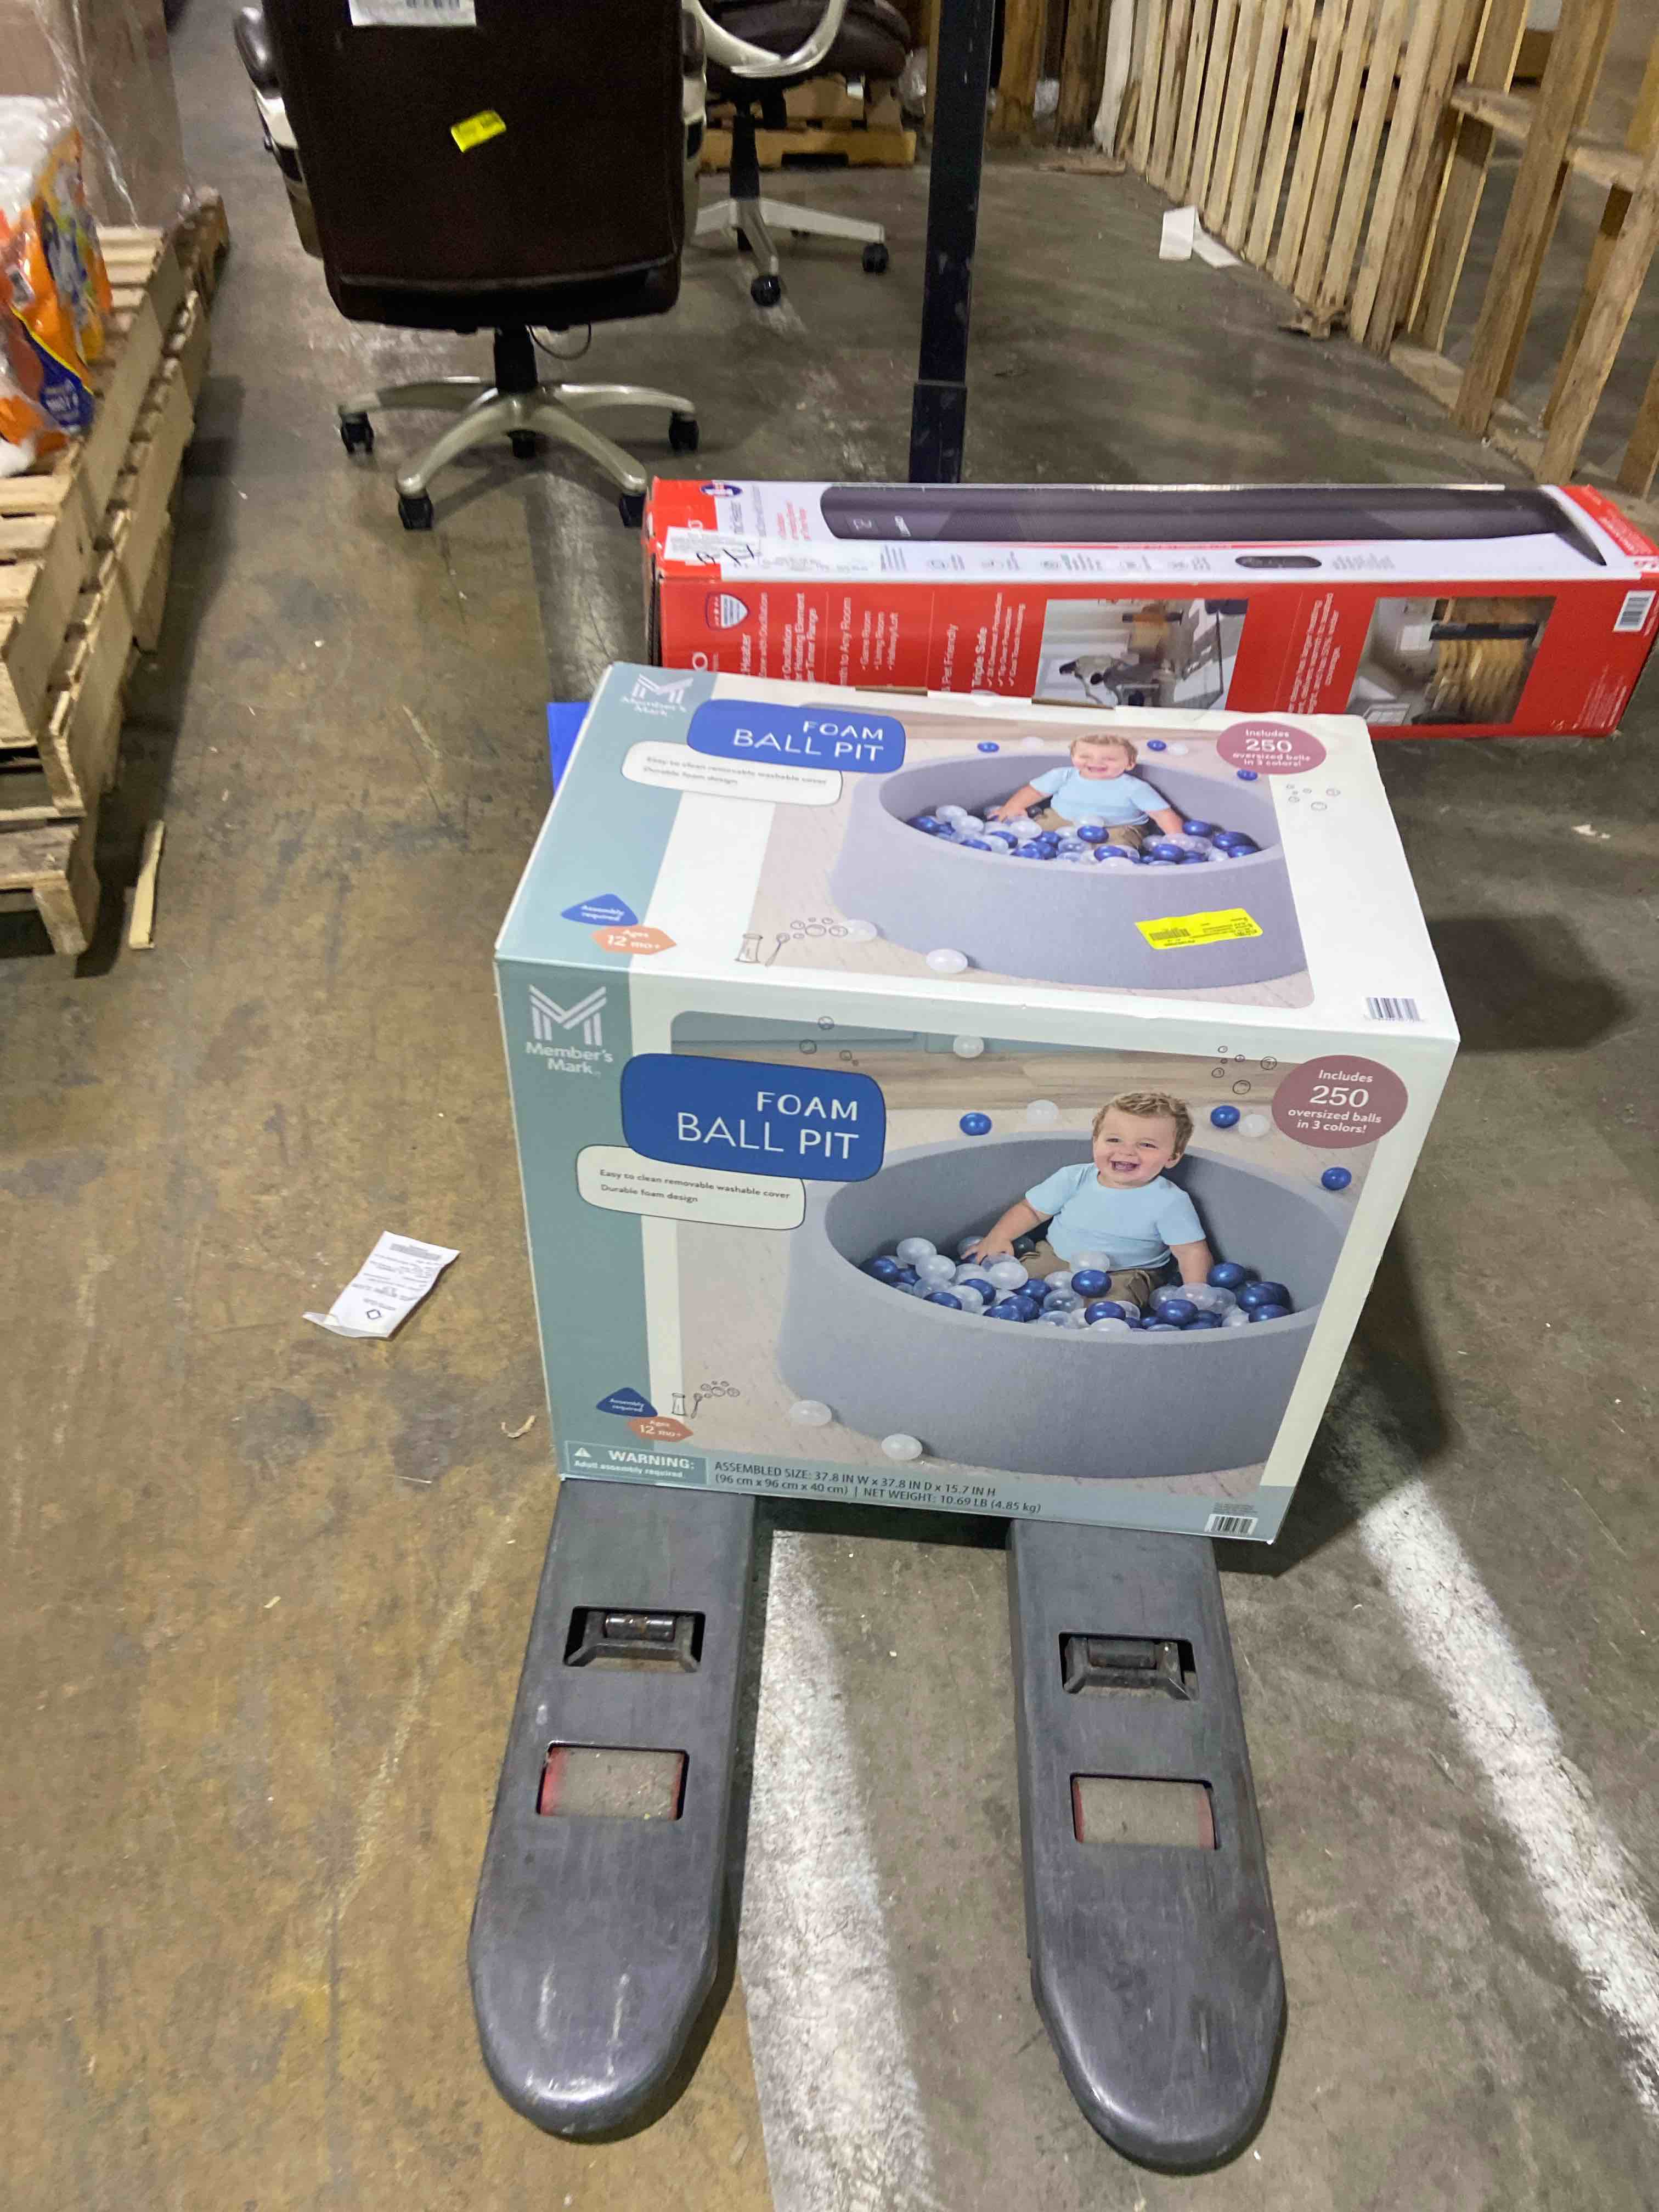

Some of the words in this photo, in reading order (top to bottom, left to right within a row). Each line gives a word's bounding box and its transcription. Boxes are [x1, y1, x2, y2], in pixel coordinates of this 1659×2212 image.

[803, 720, 883, 741] FOAM
[1246, 729, 1290, 738] Includes
[733, 728, 822, 755] BALL
[834, 741, 884, 761] PIT
[1246, 738, 1293, 753] 250
[607, 934, 628, 947] 12
[525, 1042, 613, 1063] Member's
[548, 1057, 593, 1074] Mark
[1318, 1070, 1373, 1083] Includes
[1309, 1085, 1369, 1107] 250
[756, 1091, 858, 1121] FOAM
[1288, 1108, 1350, 1121] oversized
[1352, 1112, 1382, 1124] balls
[677, 1112, 784, 1153] BALL
[799, 1128, 859, 1159] PIT
[1297, 1119, 1308, 1128] in
[1312, 1120, 1319, 1130] 3
[1323, 1122, 1367, 1133] colors!
[600, 1169, 622, 1180] Easy
[637, 1174, 662, 1183] clean
[664, 1178, 714, 1190] removable
[716, 1184, 760, 1196] washable
[763, 1190, 791, 1199] cover
[601, 1184, 638, 1195] Durable
[641, 1188, 665, 1198] foam
[667, 1191, 698, 1203] design
[640, 1424, 654, 1434] 12
[574, 1460, 597, 1469] Adult
[600, 1463, 642, 1475] assembly
[645, 1469, 684, 1478] required
[608, 1450, 695, 1470] WARNING:
[715, 1462, 782, 1476] ASSEMBLED
[785, 1468, 811, 1480] SIZE:
[815, 1471, 839, 1482] 37.8
[842, 1474, 854, 1483] IN
[857, 1476, 870, 1484] W
[881, 1478, 906, 1488] 37.8
[909, 1481, 921, 1490] IN
[924, 1482, 932, 1491] D
[945, 1484, 969, 1493] 15.7
[972, 1487, 984, 1496] IN
[988, 1488, 996, 1496] H
[715, 1474, 733, 1484] (96
[736, 1477, 753, 1486] cm
[765, 1479, 778, 1488] 96
[782, 1481, 798, 1490] cm
[811, 1483, 824, 1492] 40
[827, 1485, 848, 1495] cm)
[864, 1487, 885, 1497] NET
[888, 1490, 936, 1502] WEIGHT:
[940, 1495, 971, 1505] 10.69
[974, 1497, 988, 1507] LB
[991, 1499, 1019, 1510] (4.85
[1023, 1503, 1042, 1514] kg)
